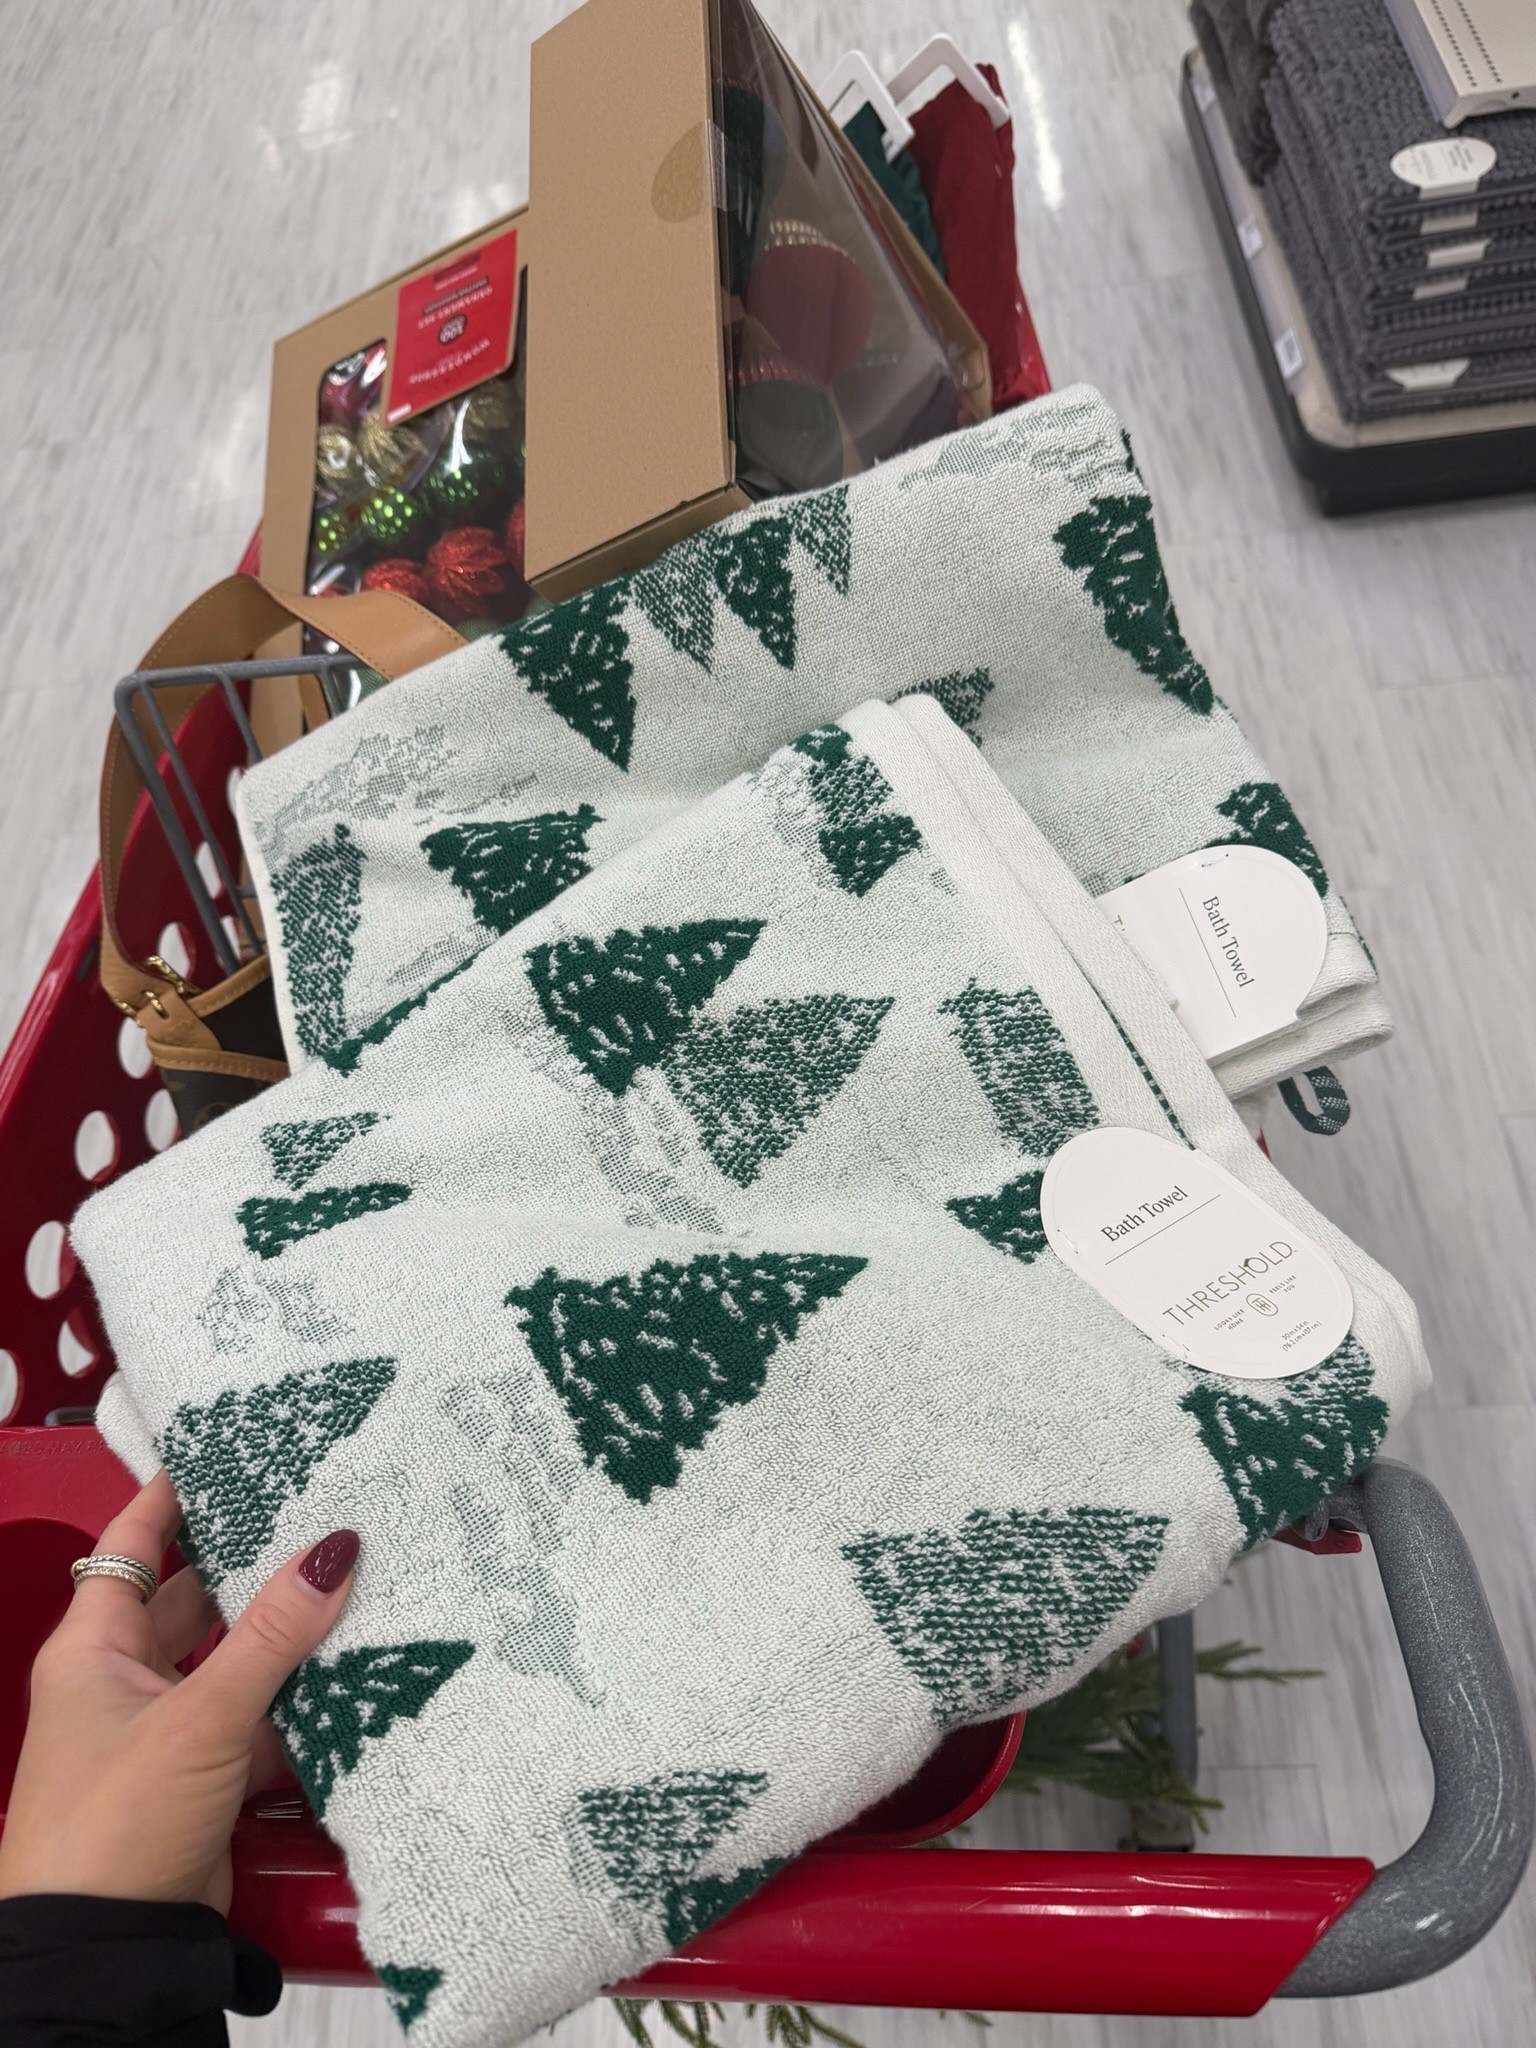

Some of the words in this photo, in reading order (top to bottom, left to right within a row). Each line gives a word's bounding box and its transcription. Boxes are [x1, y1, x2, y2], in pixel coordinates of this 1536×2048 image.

[1203, 896, 1230, 938] Bath
[1222, 936, 1255, 988] Towel
[1101, 1209, 1145, 1242] Bath
[1138, 1185, 1189, 1218] Towel
[1162, 1241, 1294, 1326] THRESHOLD
[1214, 1317, 1233, 1331] LOOKS
[1231, 1308, 1245, 1319] LIKE
